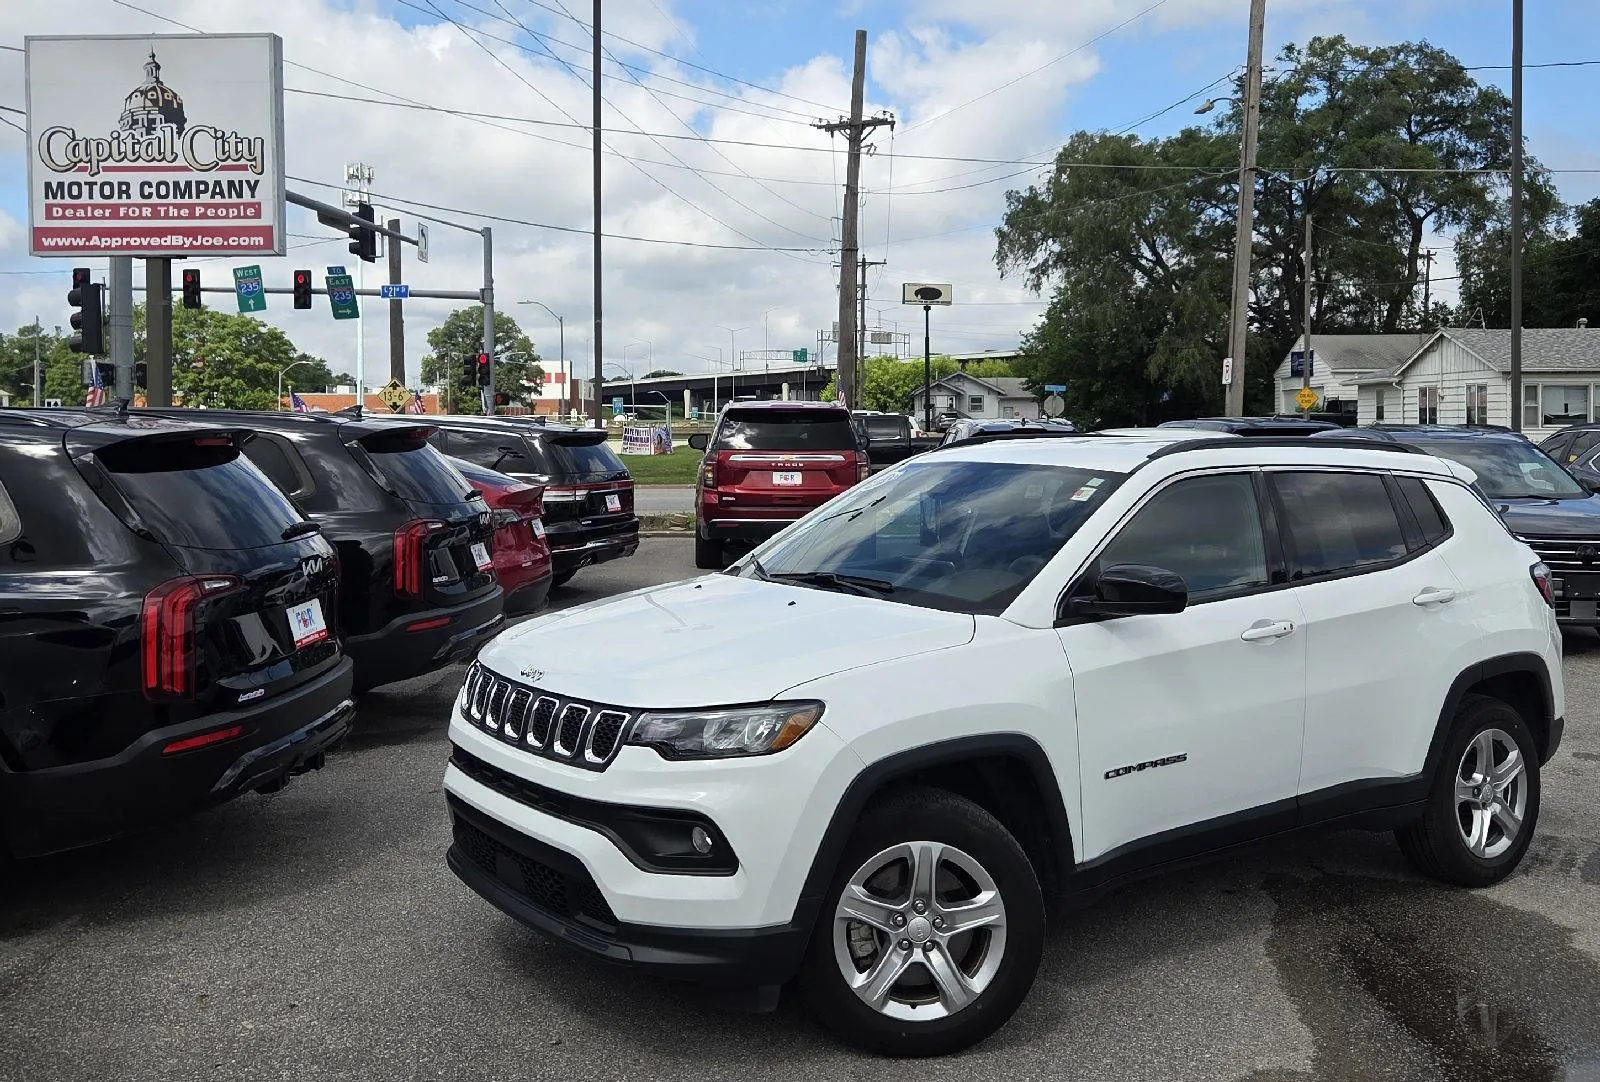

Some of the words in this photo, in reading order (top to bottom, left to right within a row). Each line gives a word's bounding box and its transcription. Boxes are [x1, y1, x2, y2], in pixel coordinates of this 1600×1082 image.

[38, 124, 178, 177] Capital
[182, 124, 265, 175] City
[44, 181, 131, 200] MOTOR
[139, 179, 260, 200] COMPANY
[52, 206, 111, 217] Dealer
[119, 206, 151, 217] FOR
[157, 206, 189, 217] The
[195, 205, 256, 220] People
[42, 234, 264, 248] www.ApprovedByJoe.com
[240, 283, 259, 293] 235
[333, 292, 352, 301] 235
[1103, 752, 1188, 780] COMPASS
